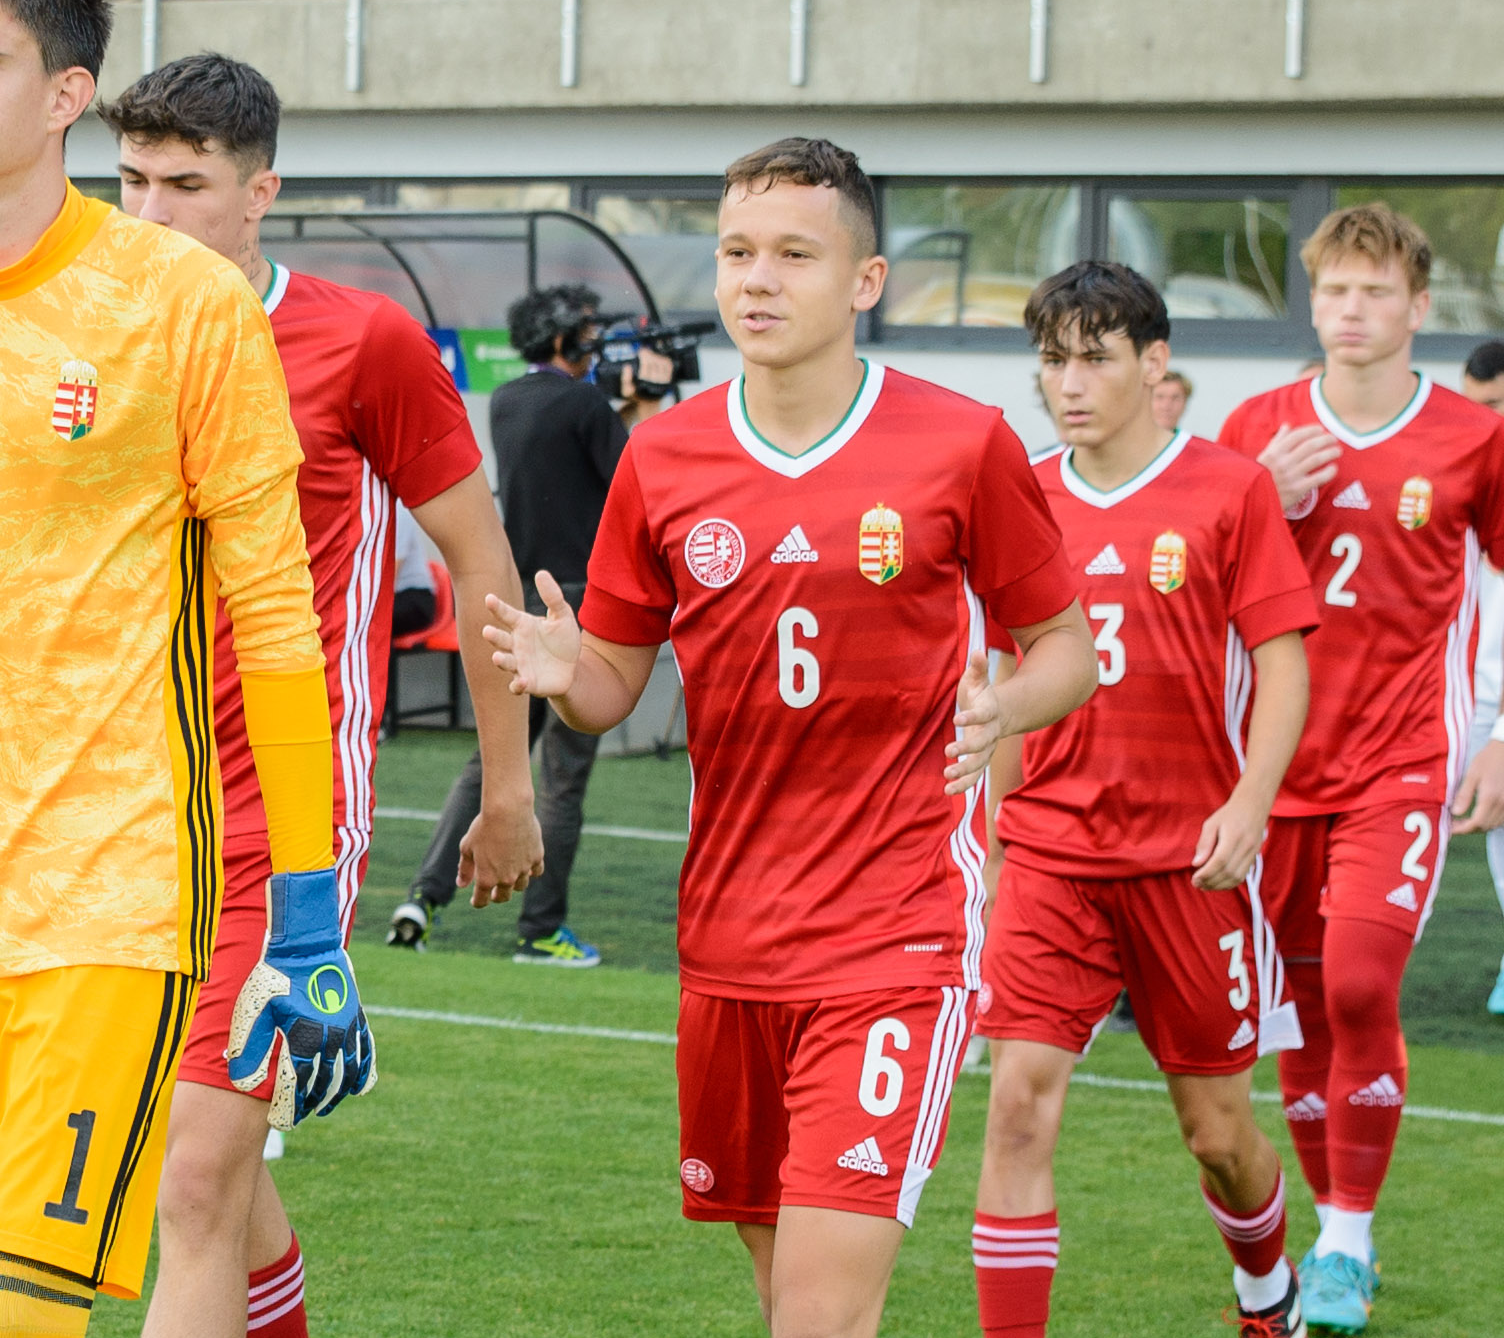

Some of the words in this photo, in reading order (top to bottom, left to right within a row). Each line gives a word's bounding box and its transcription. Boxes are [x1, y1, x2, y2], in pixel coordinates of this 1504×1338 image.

[770, 549, 819, 564] adidas
[1325, 533, 1362, 608] 2
[776, 607, 820, 709] 6
[1089, 604, 1126, 686] 3
[1401, 811, 1433, 882] 2
[1219, 929, 1251, 1011] 3
[858, 1017, 910, 1118] 6
[43, 1109, 96, 1225] 1
[837, 1155, 889, 1177] adidas
